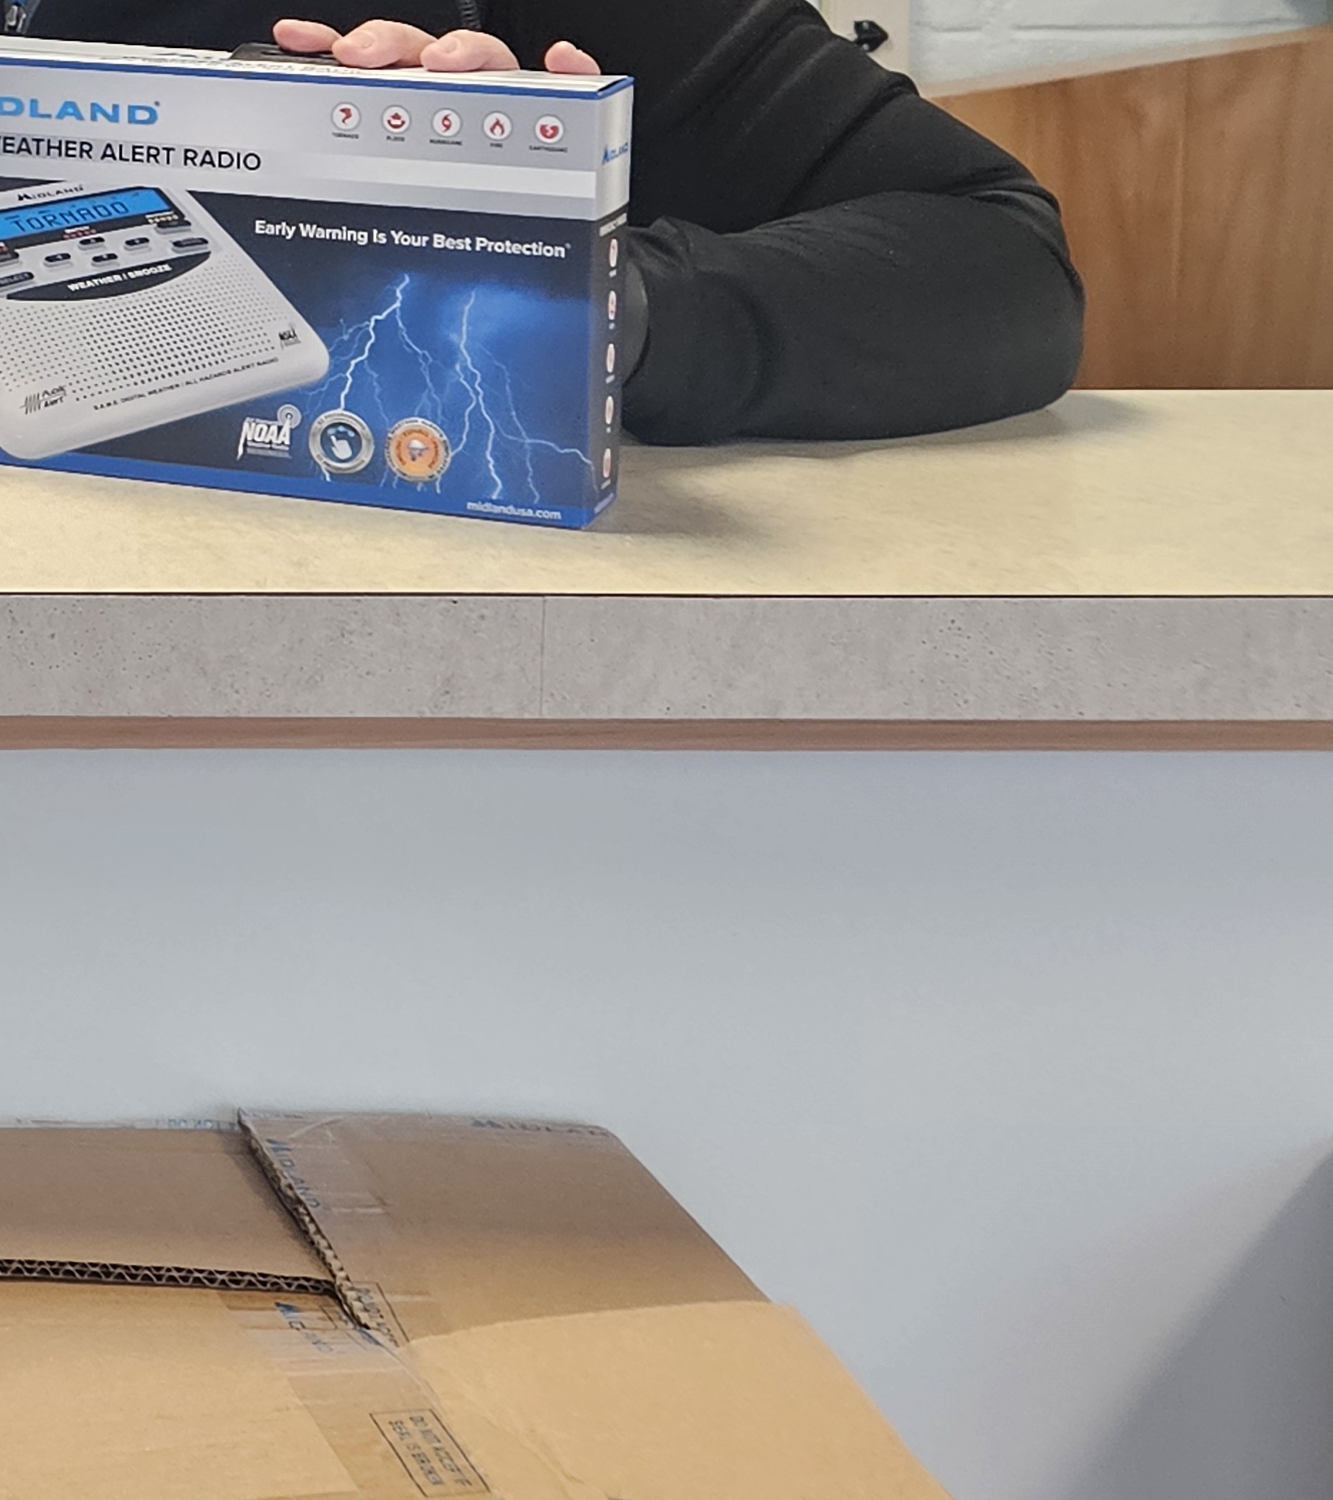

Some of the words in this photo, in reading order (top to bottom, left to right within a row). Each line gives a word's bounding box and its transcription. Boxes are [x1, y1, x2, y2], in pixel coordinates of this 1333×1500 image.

[100, 142, 175, 166] ALERT
[183, 148, 262, 171] RADIO
[17, 186, 81, 202] MIDLAND
[11, 201, 129, 233] TORNADO
[255, 220, 294, 242] Early
[299, 223, 369, 246] Warning
[372, 229, 387, 244] Is
[390, 231, 429, 248] Your
[433, 233, 472, 251] Best
[475, 236, 565, 258] Protection
[68, 273, 122, 292] WEATHER
[237, 420, 290, 454] NOAA
[467, 500, 562, 520] midlandusa.com
